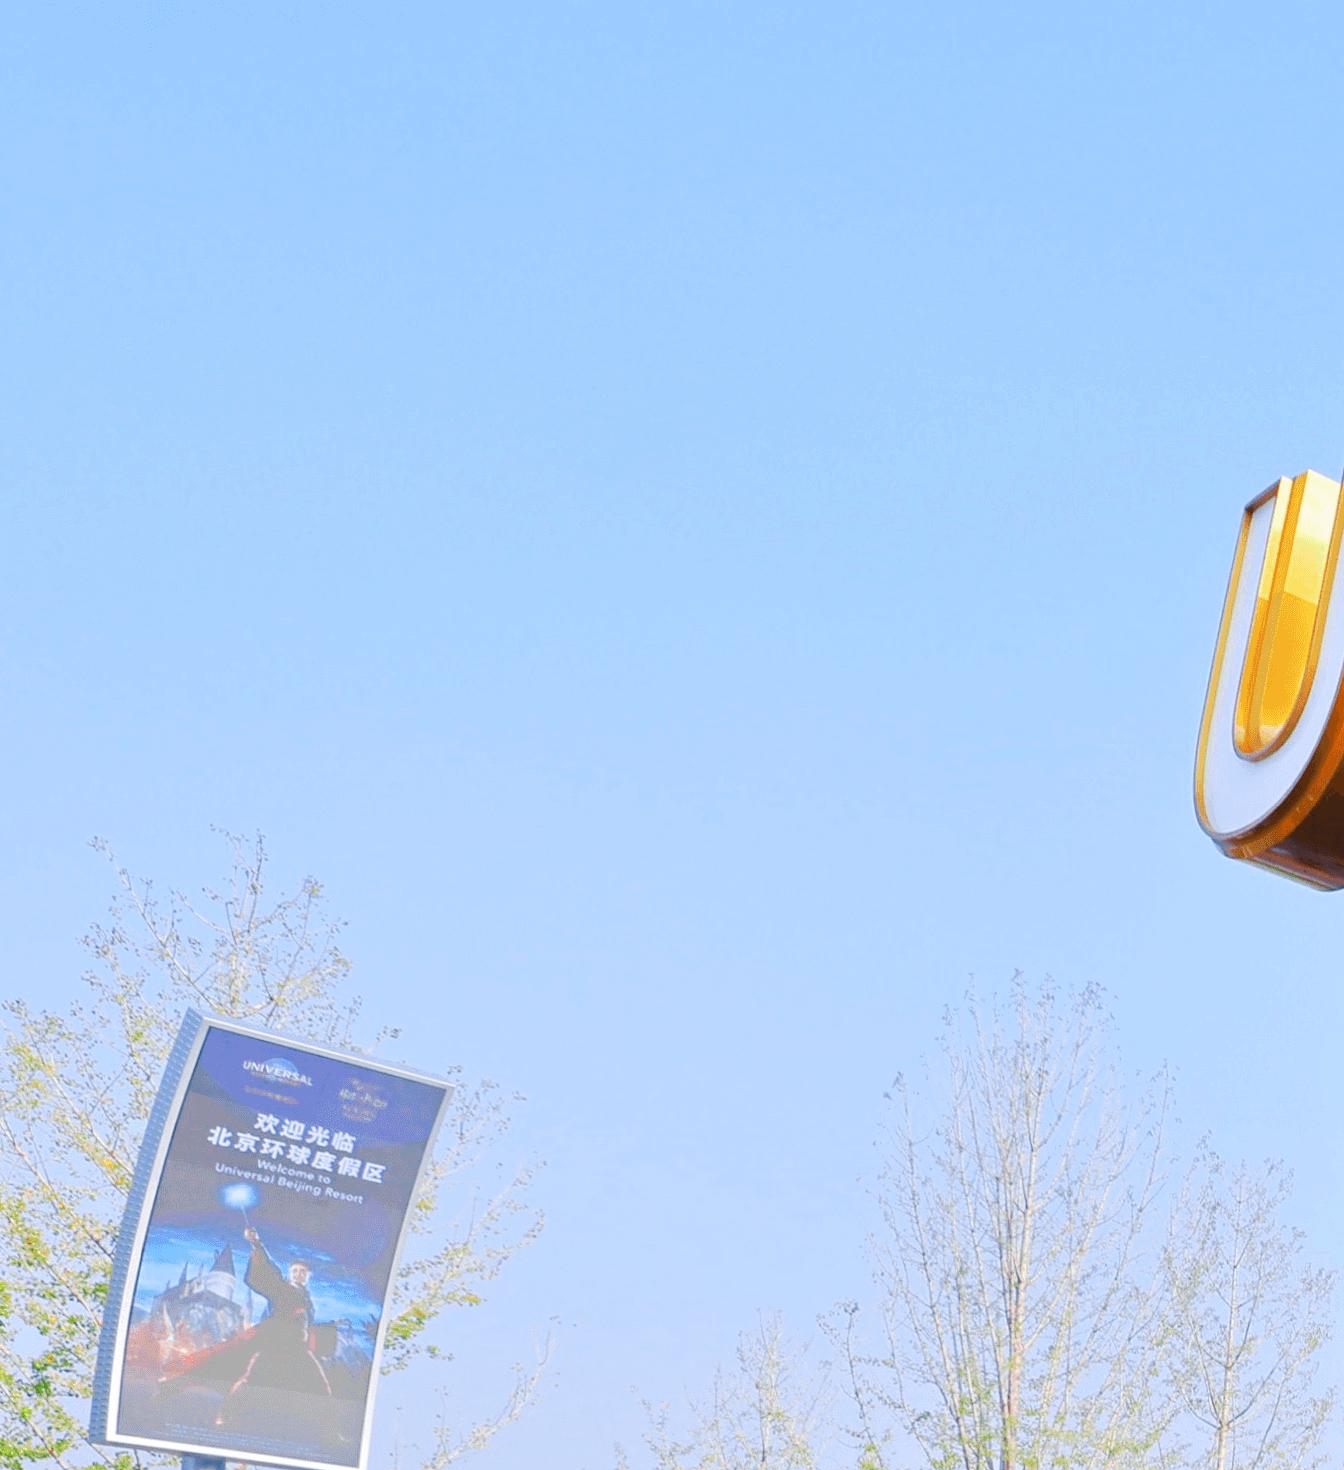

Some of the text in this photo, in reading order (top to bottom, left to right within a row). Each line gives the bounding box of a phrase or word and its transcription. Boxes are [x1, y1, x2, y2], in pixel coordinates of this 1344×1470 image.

[242, 1060, 313, 1087] UNIVERSAL
[254, 1113, 357, 1153] 欢迎光临
[207, 1125, 387, 1184] 北京环球度假区
[257, 1158, 332, 1185] Welcome to
[215, 1162, 364, 1204] Universal Beijing Resort
